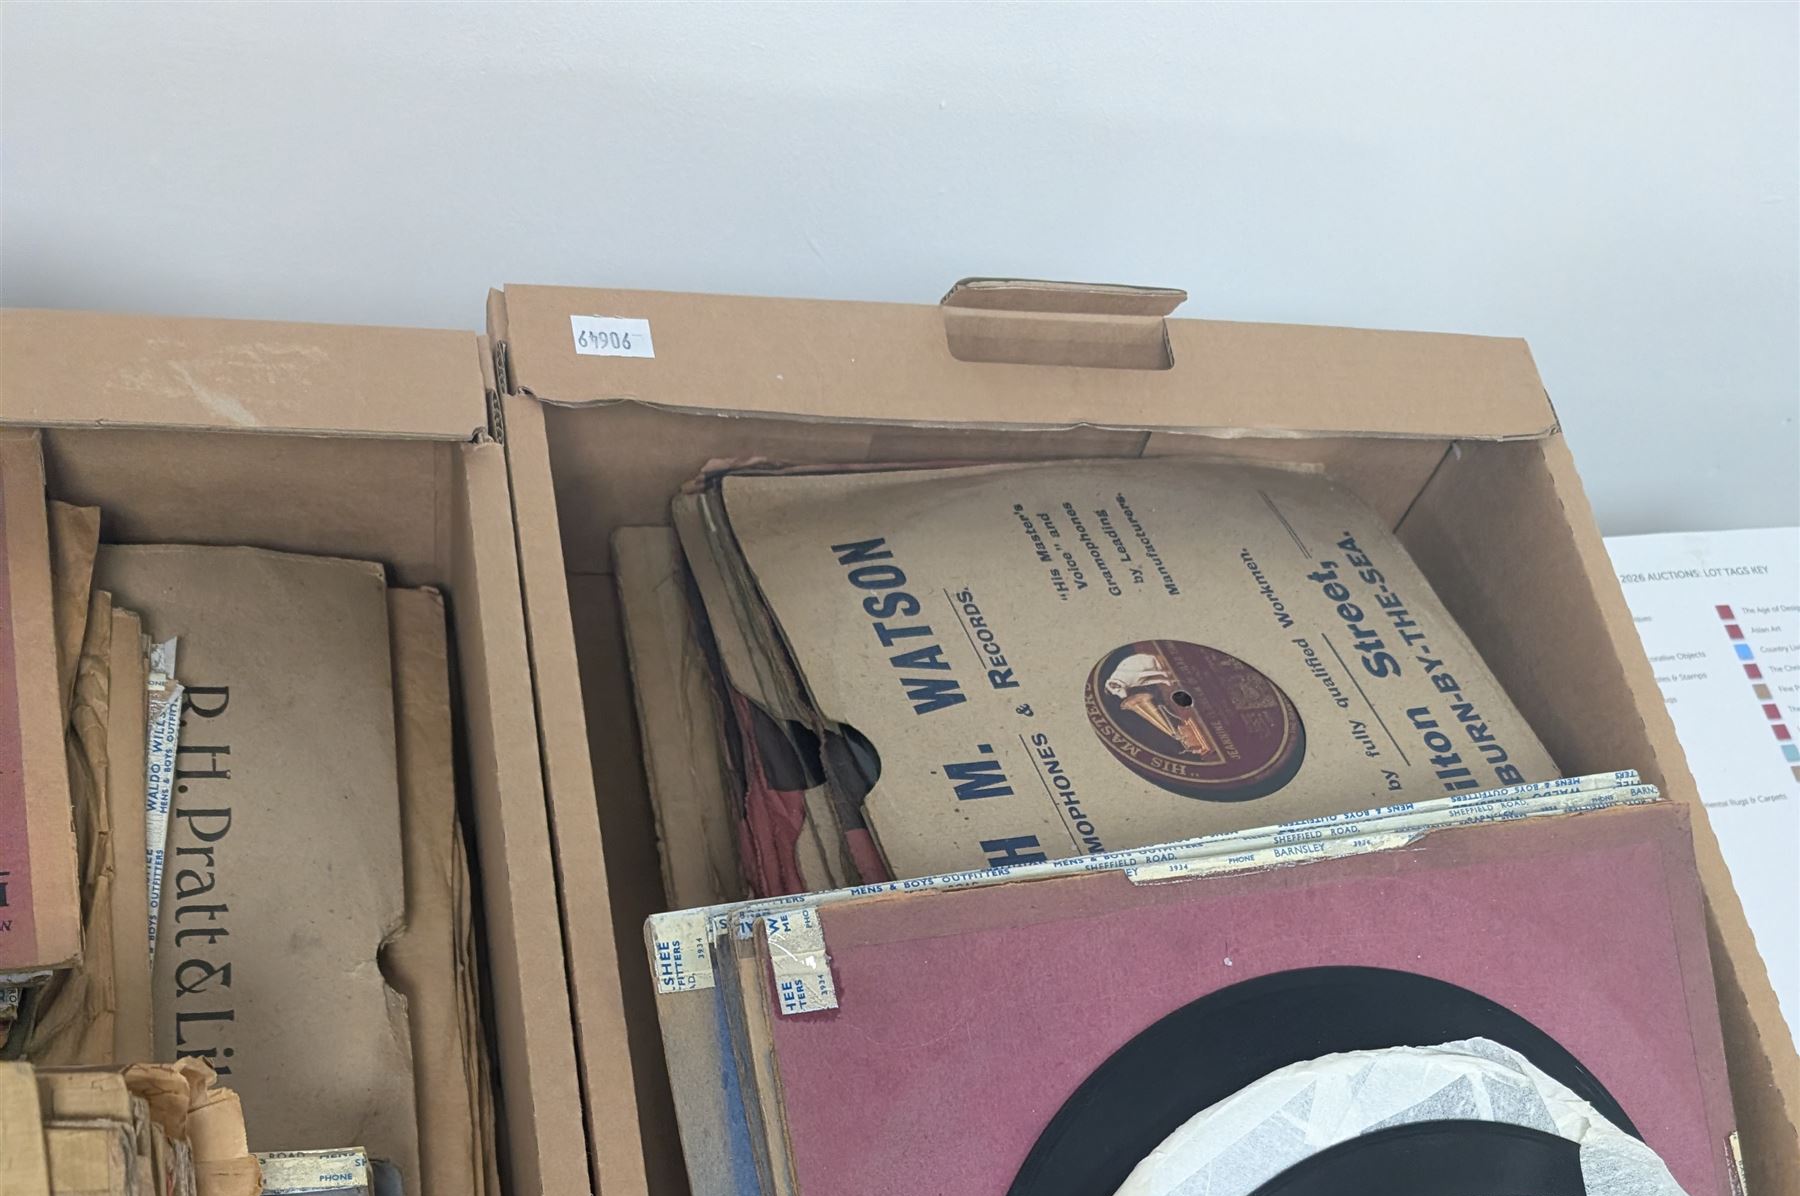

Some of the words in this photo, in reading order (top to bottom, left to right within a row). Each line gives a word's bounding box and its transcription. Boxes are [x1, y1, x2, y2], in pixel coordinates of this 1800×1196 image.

[578, 330, 631, 350] 64906
[1013, 503, 1052, 562] Master's
[1036, 512, 1060, 538] and
[1094, 509, 1131, 563] Leading
[1062, 502, 1122, 597] Gramophones
[1116, 492, 1181, 596] Manufacturers.
[1129, 567, 1144, 584] by
[1620, 573, 1646, 583] 2026
[1703, 567, 1723, 577] LOT
[1723, 566, 1750, 577] TAGS
[1752, 565, 1769, 575] KEY
[830, 537, 967, 715] WATSON
[1307, 560, 1402, 678] Street,
[955, 586, 1020, 689] RECORDS.
[1336, 531, 1526, 786] BURN-BY-THE-SEA.
[1292, 638, 1349, 709] qualified
[1015, 703, 1035, 717] &
[1349, 720, 1380, 758] fully
[164, 749, 173, 773] BOYS
[942, 743, 1015, 801] M.
[146, 763, 161, 812] WALDO
[1381, 768, 1403, 791] by
[1515, 784, 1539, 793] BOYS
[1555, 777, 1581, 787] MENS
[159, 789, 170, 814] MENS
[1451, 789, 1508, 802] OUTFITTERS
[1343, 809, 1370, 819] BOYS
[1387, 803, 1414, 814] MENS
[1449, 804, 1494, 817] SHEFFIELD
[1273, 830, 1322, 844] SHEFFIELD
[1330, 825, 1361, 837] ROAD.
[1145, 852, 1178, 864] ROAD.
[1273, 842, 1326, 858] BARNSLEY
[1053, 858, 1084, 868] MENS
[1168, 863, 1188, 872] 3934
[1228, 854, 1256, 865] PHONE
[151, 849, 164, 908] OUTFITTERS
[175, 808, 232, 948] Pratt
[851, 885, 883, 896] MENS
[889, 883, 897, 891] &
[904, 878, 935, 889] BOYS
[942, 867, 1011, 884] OUTFITTERS
[696, 937, 705, 959] 3934
[175, 959, 232, 998] &
[817, 974, 828, 996] 3934
[319, 1173, 353, 1182] PHONE
